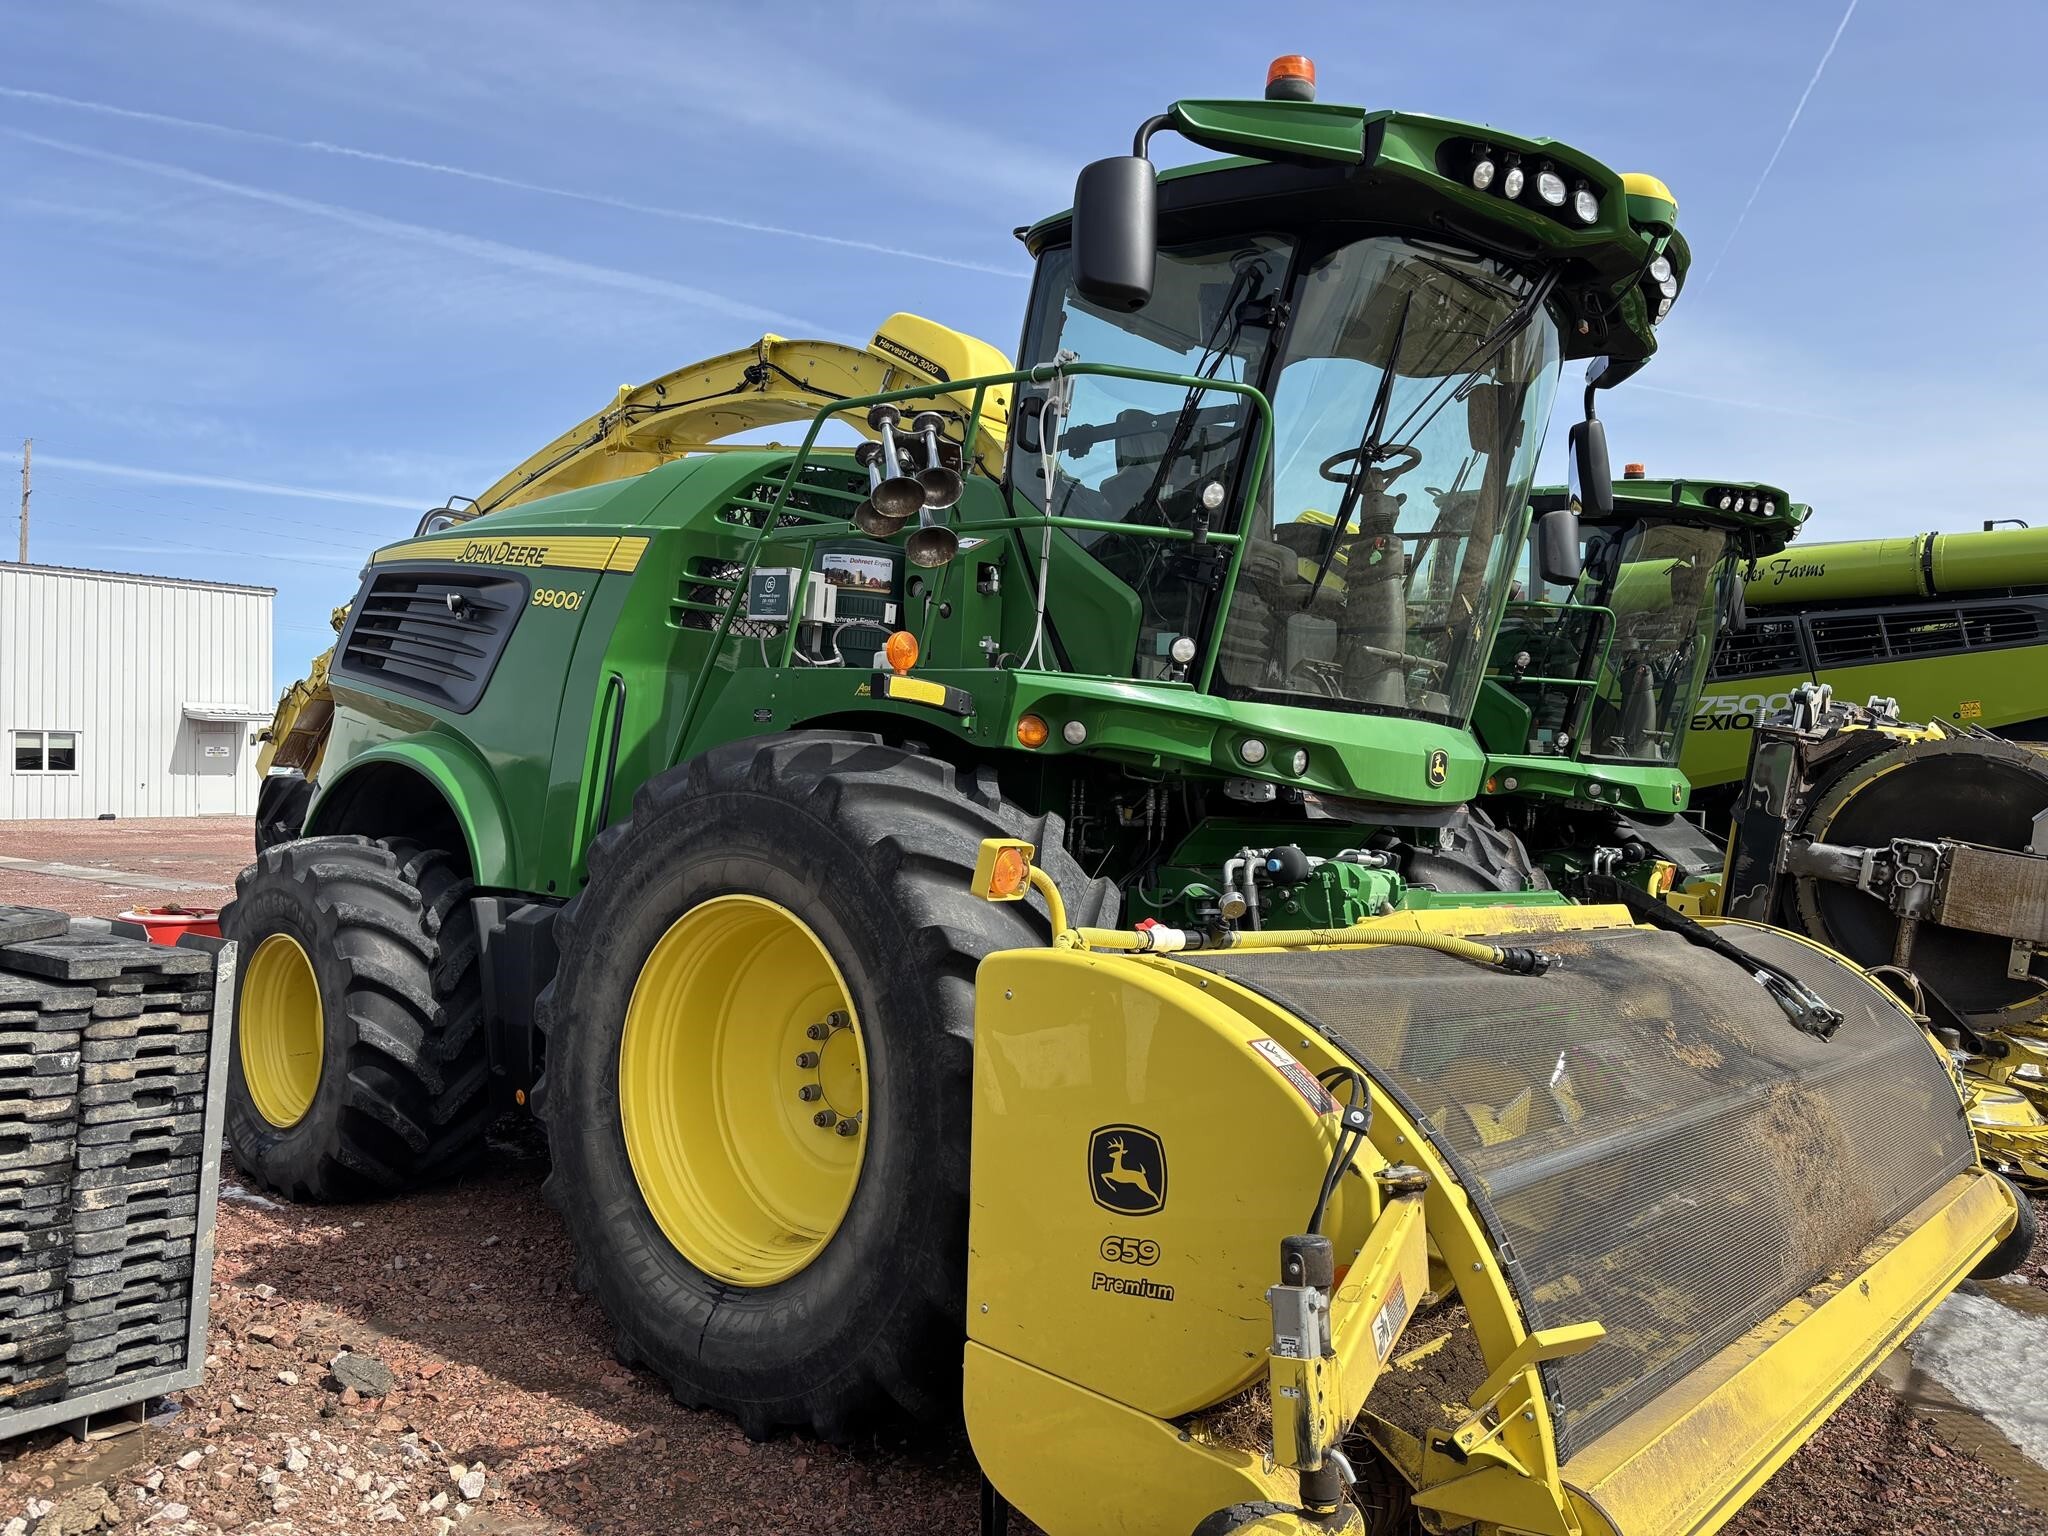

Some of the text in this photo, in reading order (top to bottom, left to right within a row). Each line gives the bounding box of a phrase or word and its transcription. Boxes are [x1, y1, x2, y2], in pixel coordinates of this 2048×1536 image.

[879, 338, 939, 374] HarvestLab 3000
[456, 540, 549, 565] JOHN DEERE
[1737, 558, 1826, 586] der Farms
[531, 588, 586, 611] 9900i
[835, 616, 858, 624] ohrect
[1695, 693, 1794, 716] 7500
[1690, 713, 1756, 731] EXIO
[1100, 1235, 1161, 1267] 659
[1091, 1272, 1175, 1301] Premium
